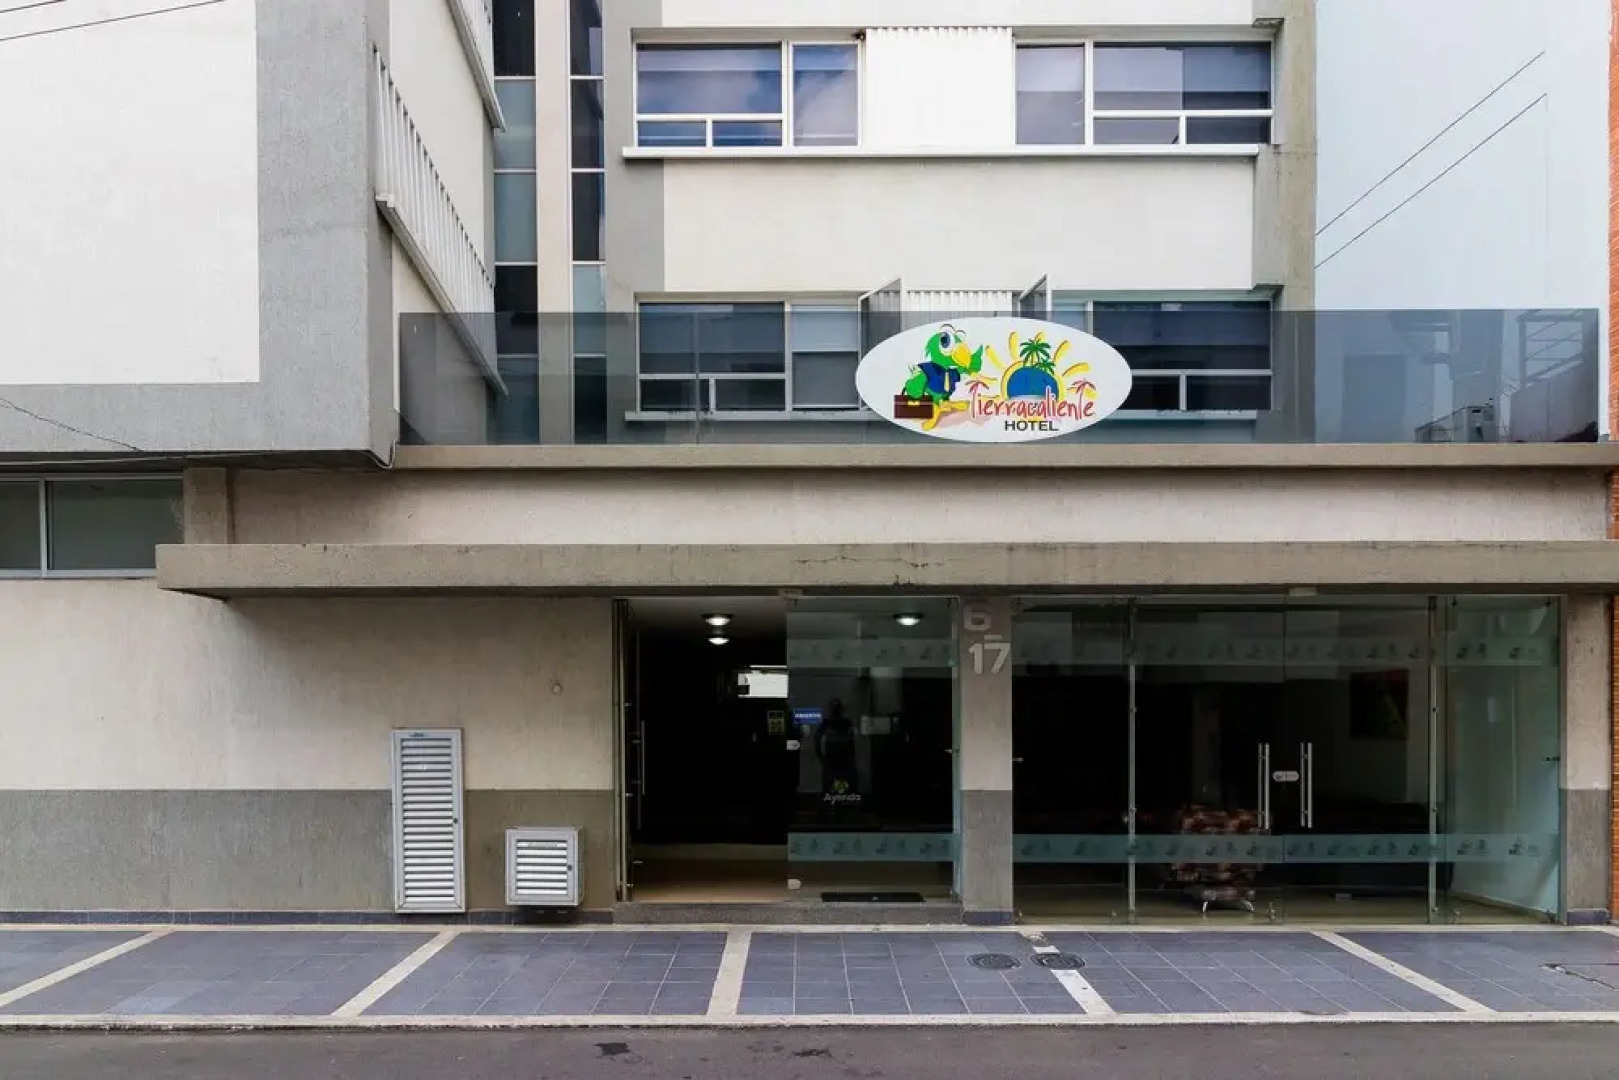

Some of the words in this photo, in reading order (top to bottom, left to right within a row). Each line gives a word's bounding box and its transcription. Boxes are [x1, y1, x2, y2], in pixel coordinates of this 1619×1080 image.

[1004, 420, 1059, 431] HOTEL
[963, 602, 992, 631] 6
[968, 642, 1011, 675] 17
